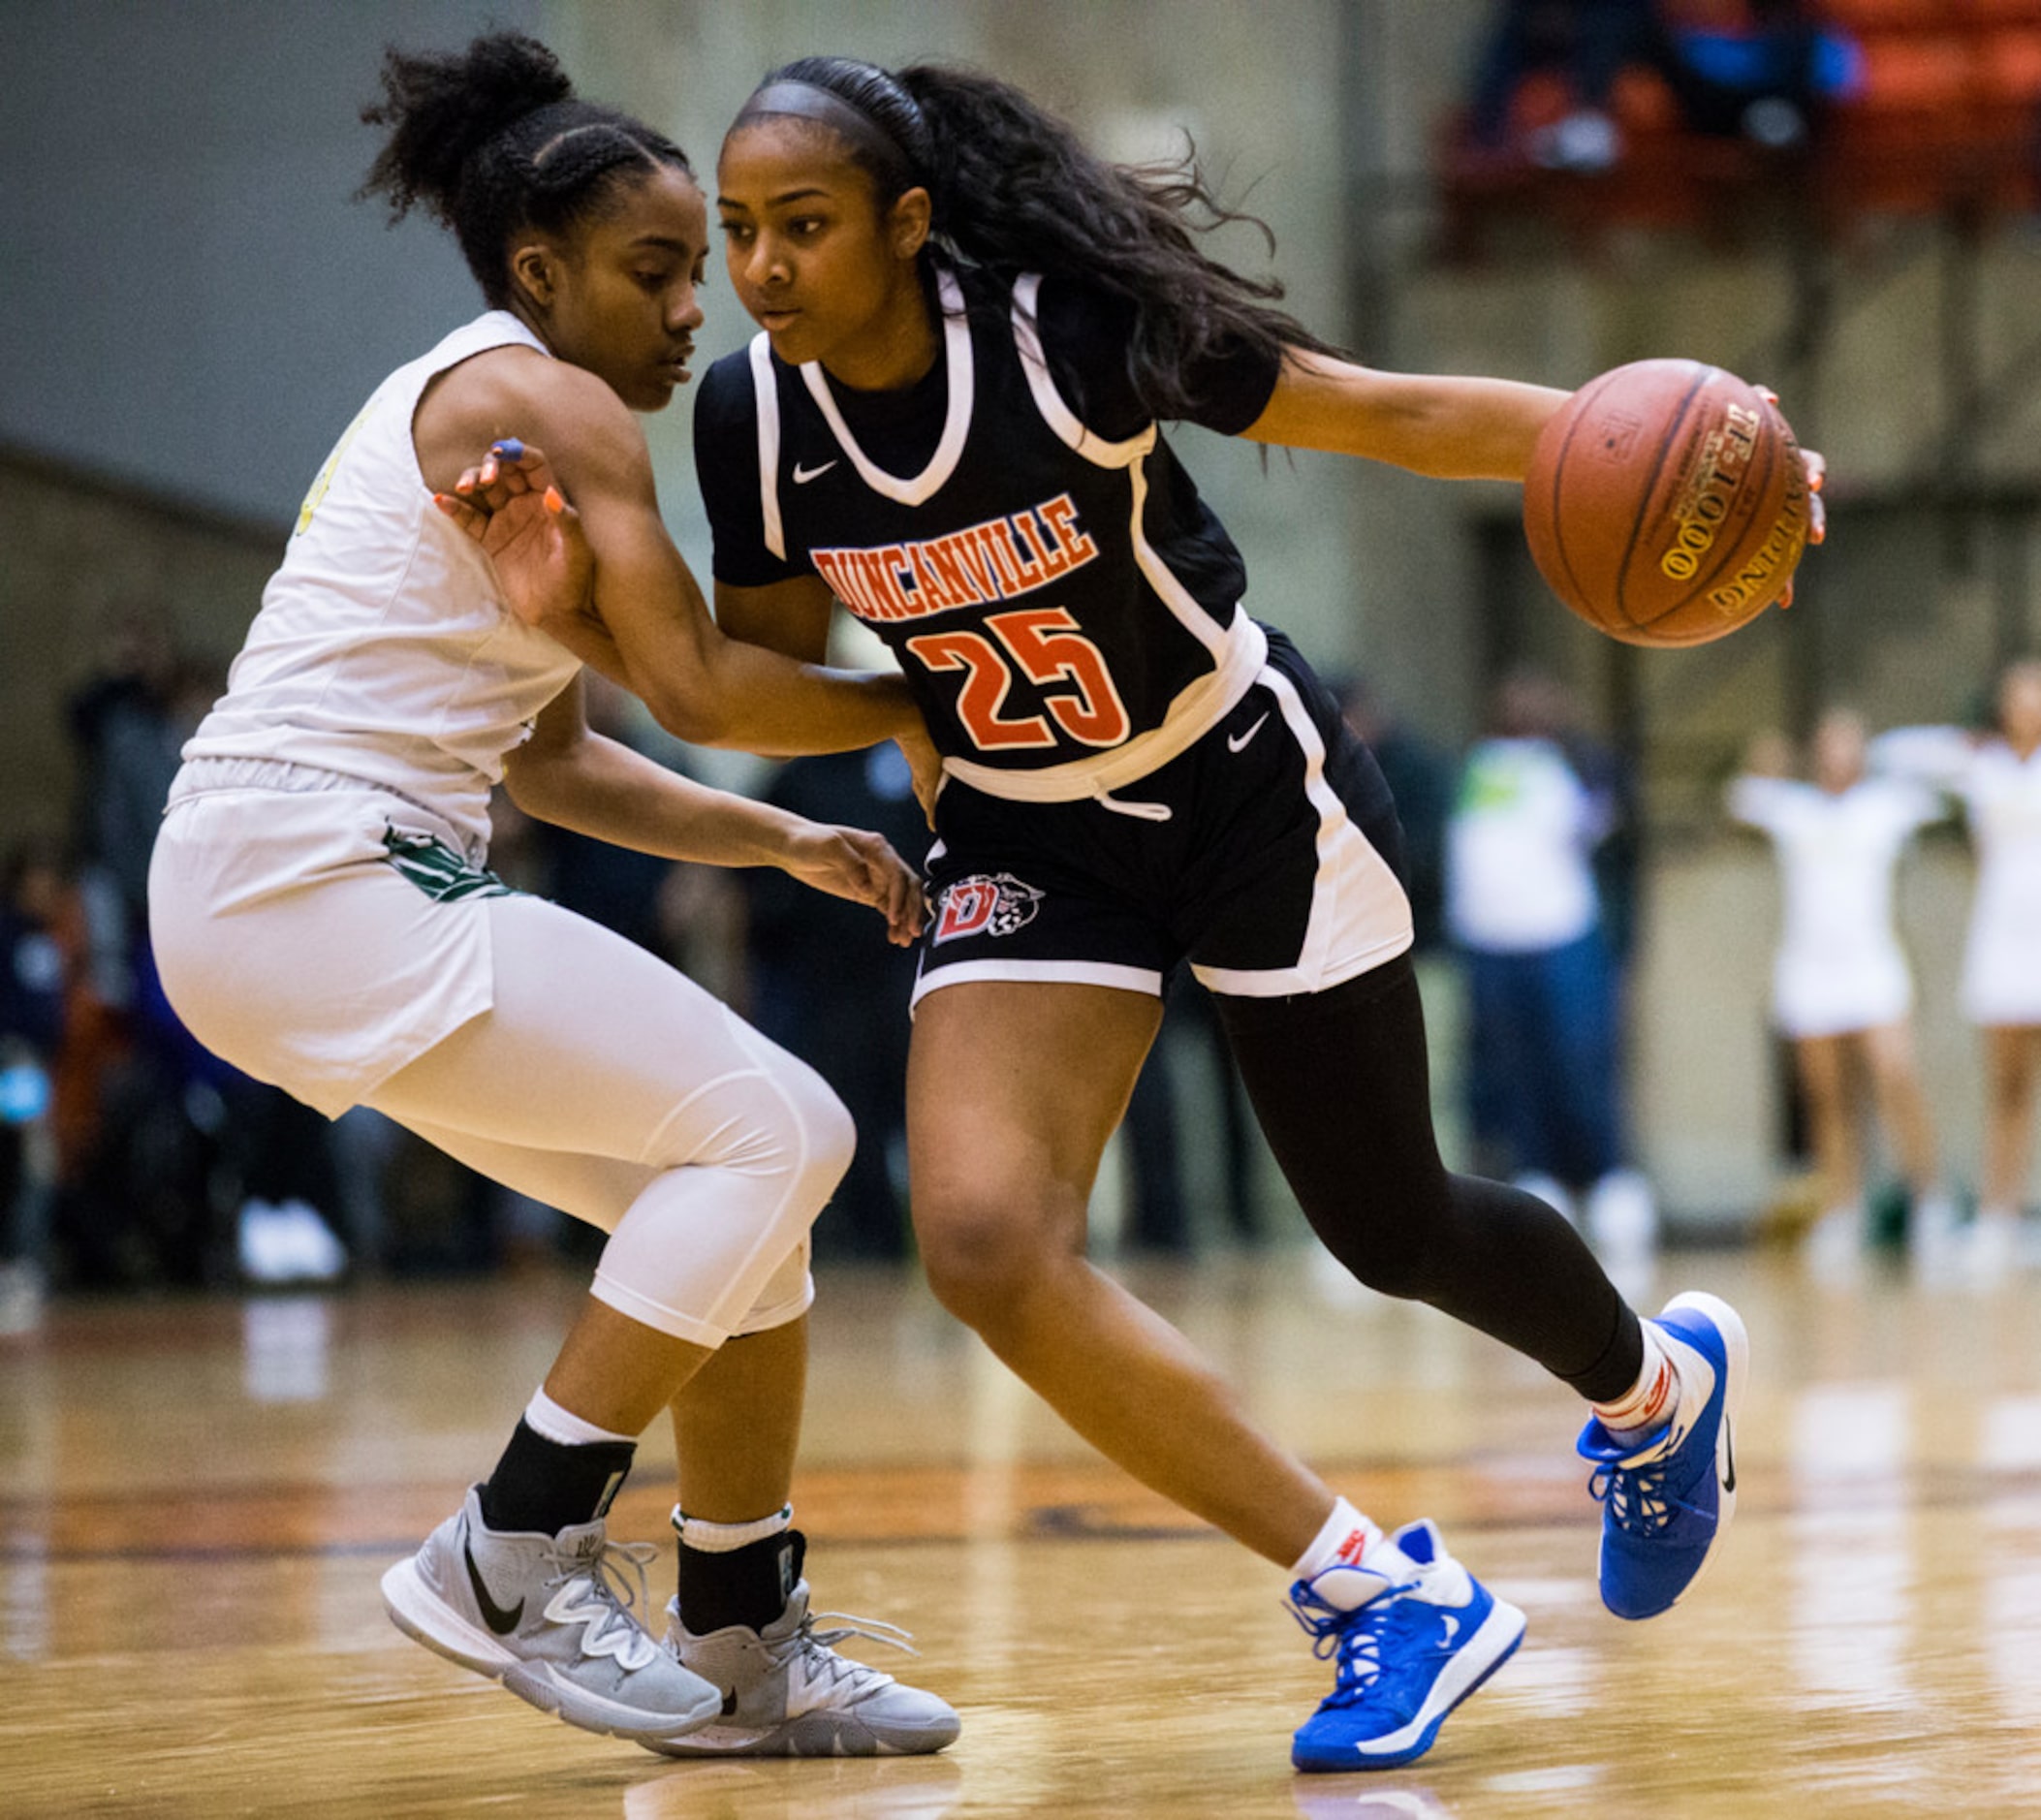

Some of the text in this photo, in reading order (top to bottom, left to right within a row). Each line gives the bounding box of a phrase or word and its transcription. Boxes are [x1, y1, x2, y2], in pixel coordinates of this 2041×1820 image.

[808, 492, 1099, 622] DUNCANVILLE
[1661, 403, 1760, 581] TF-1000
[906, 607, 1131, 751] 25
